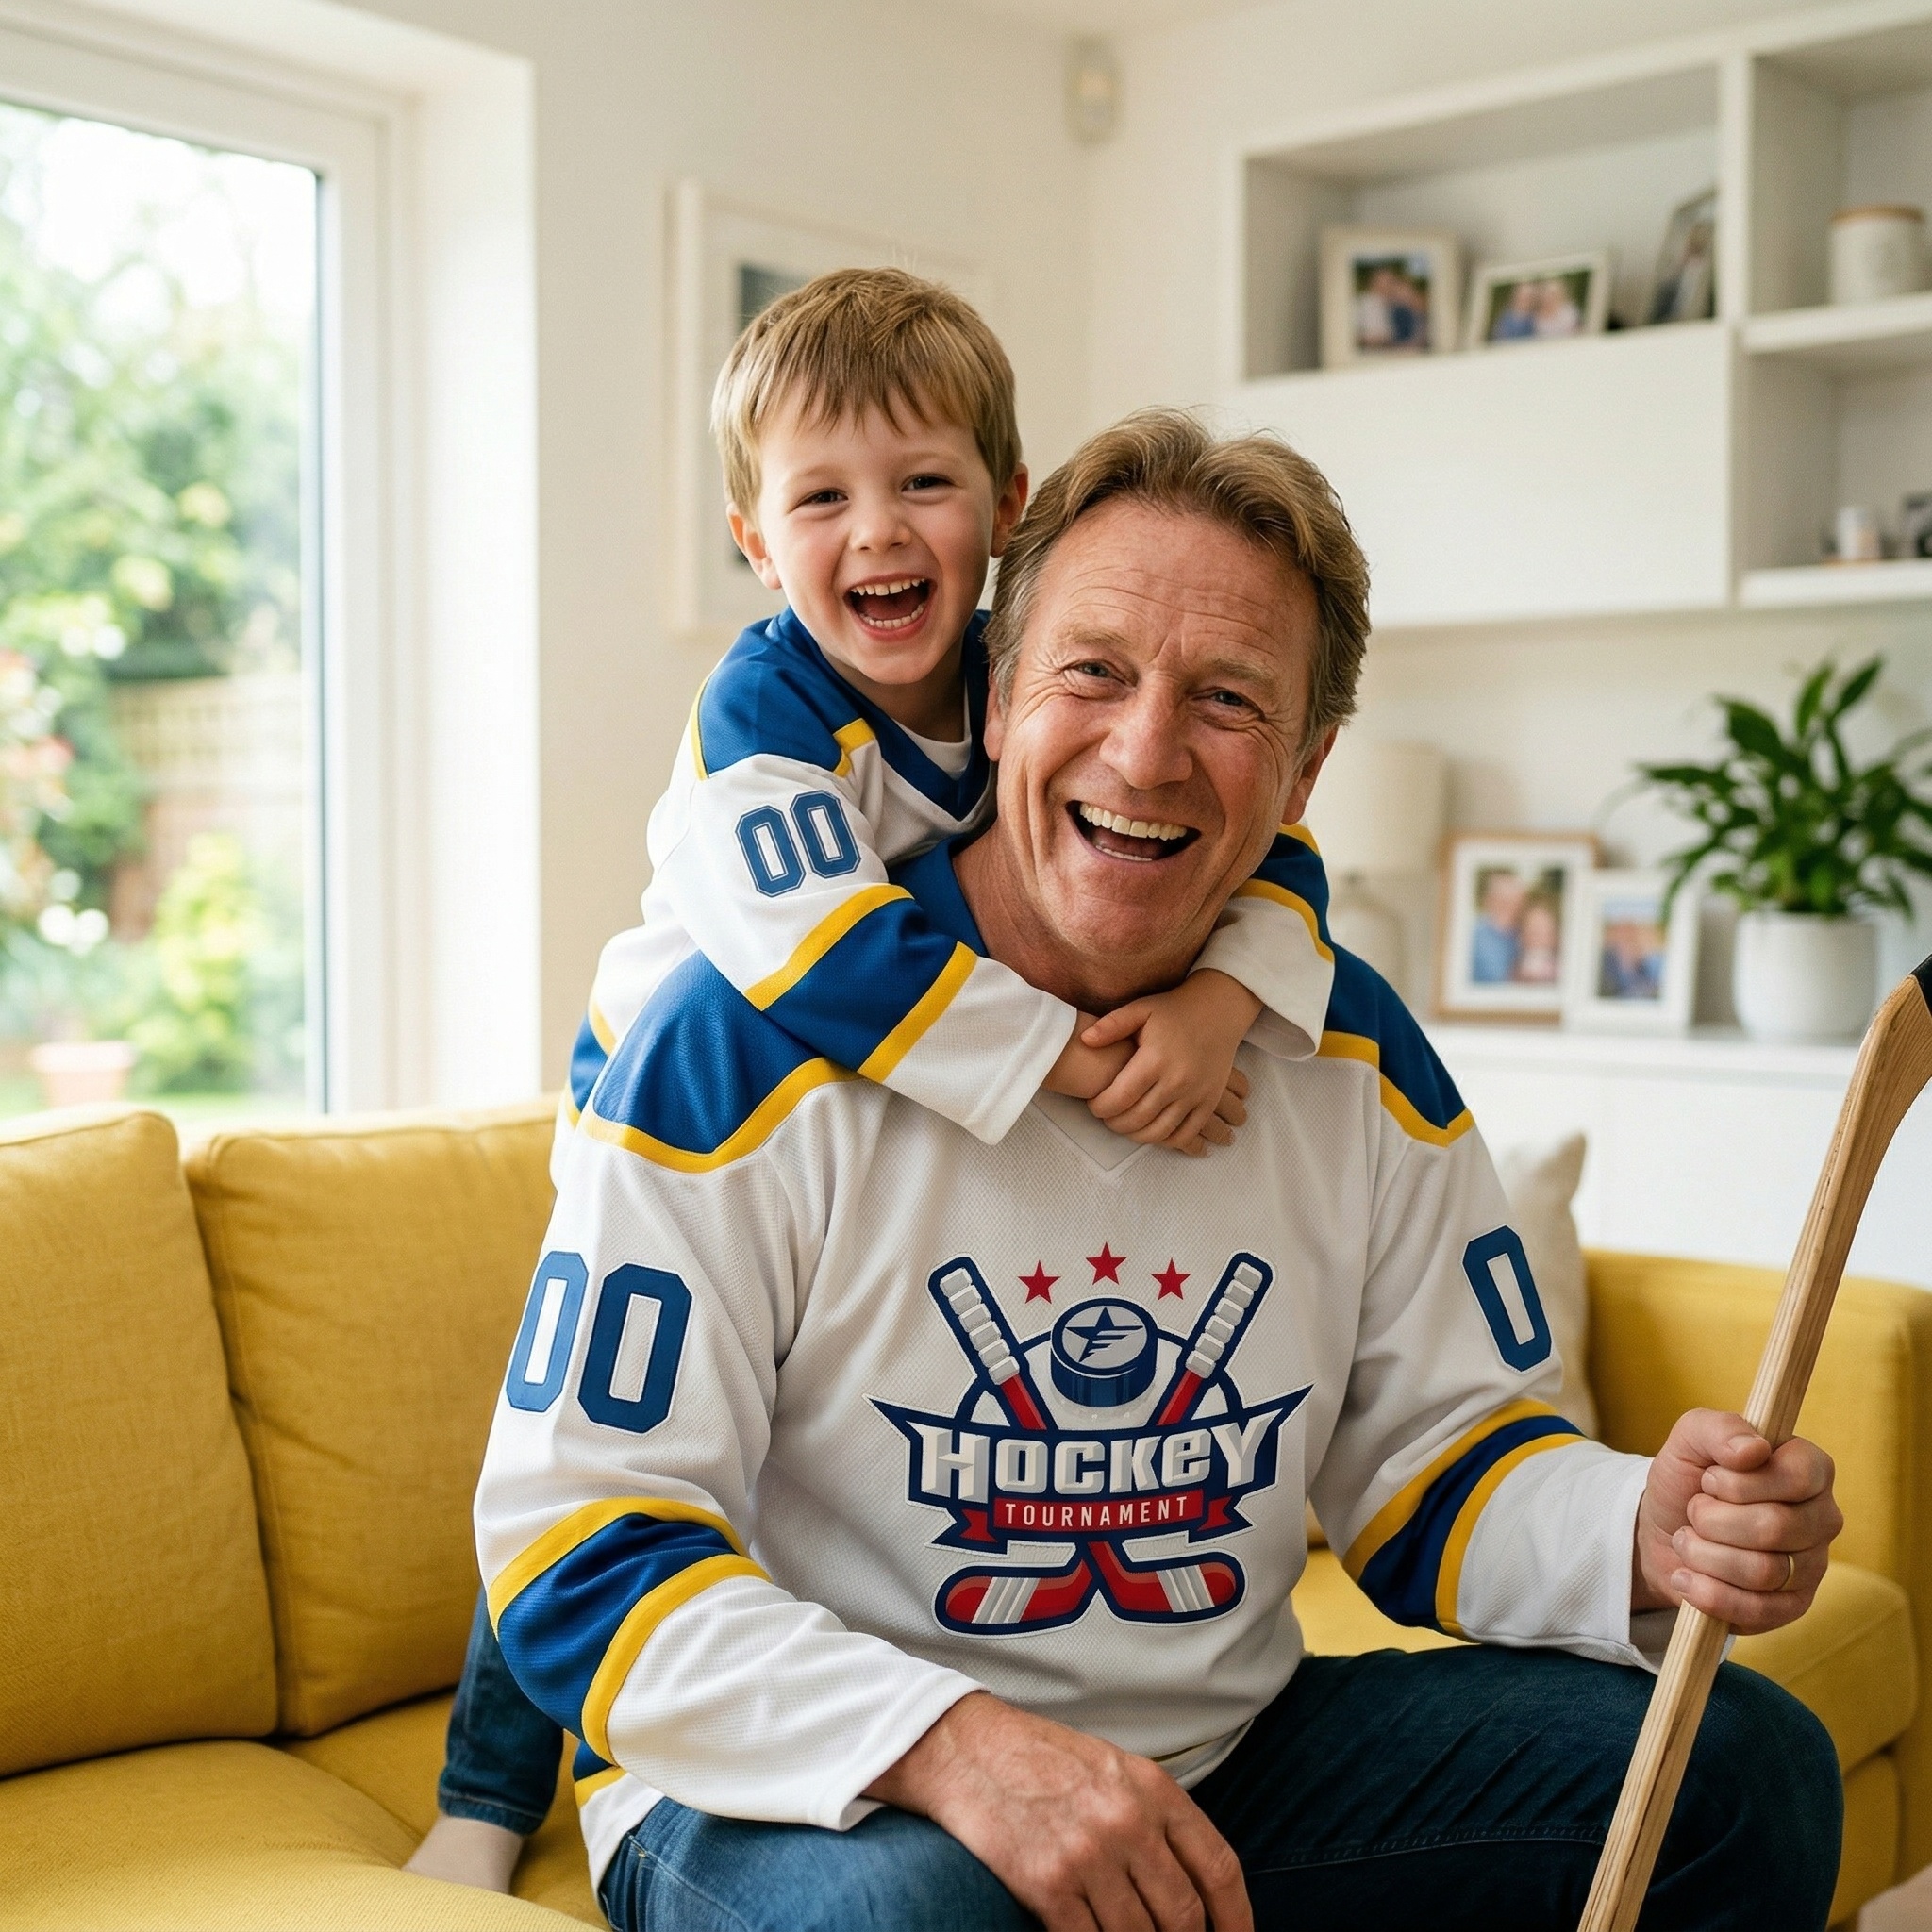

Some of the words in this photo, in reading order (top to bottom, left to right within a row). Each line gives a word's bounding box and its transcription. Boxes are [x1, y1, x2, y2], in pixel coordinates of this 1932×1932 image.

[735, 790, 861, 898] 00
[506, 1251, 692, 1434] 00
[1462, 1224, 1552, 1373] 0
[1005, 1496, 1188, 1527] TOURNAMENT
